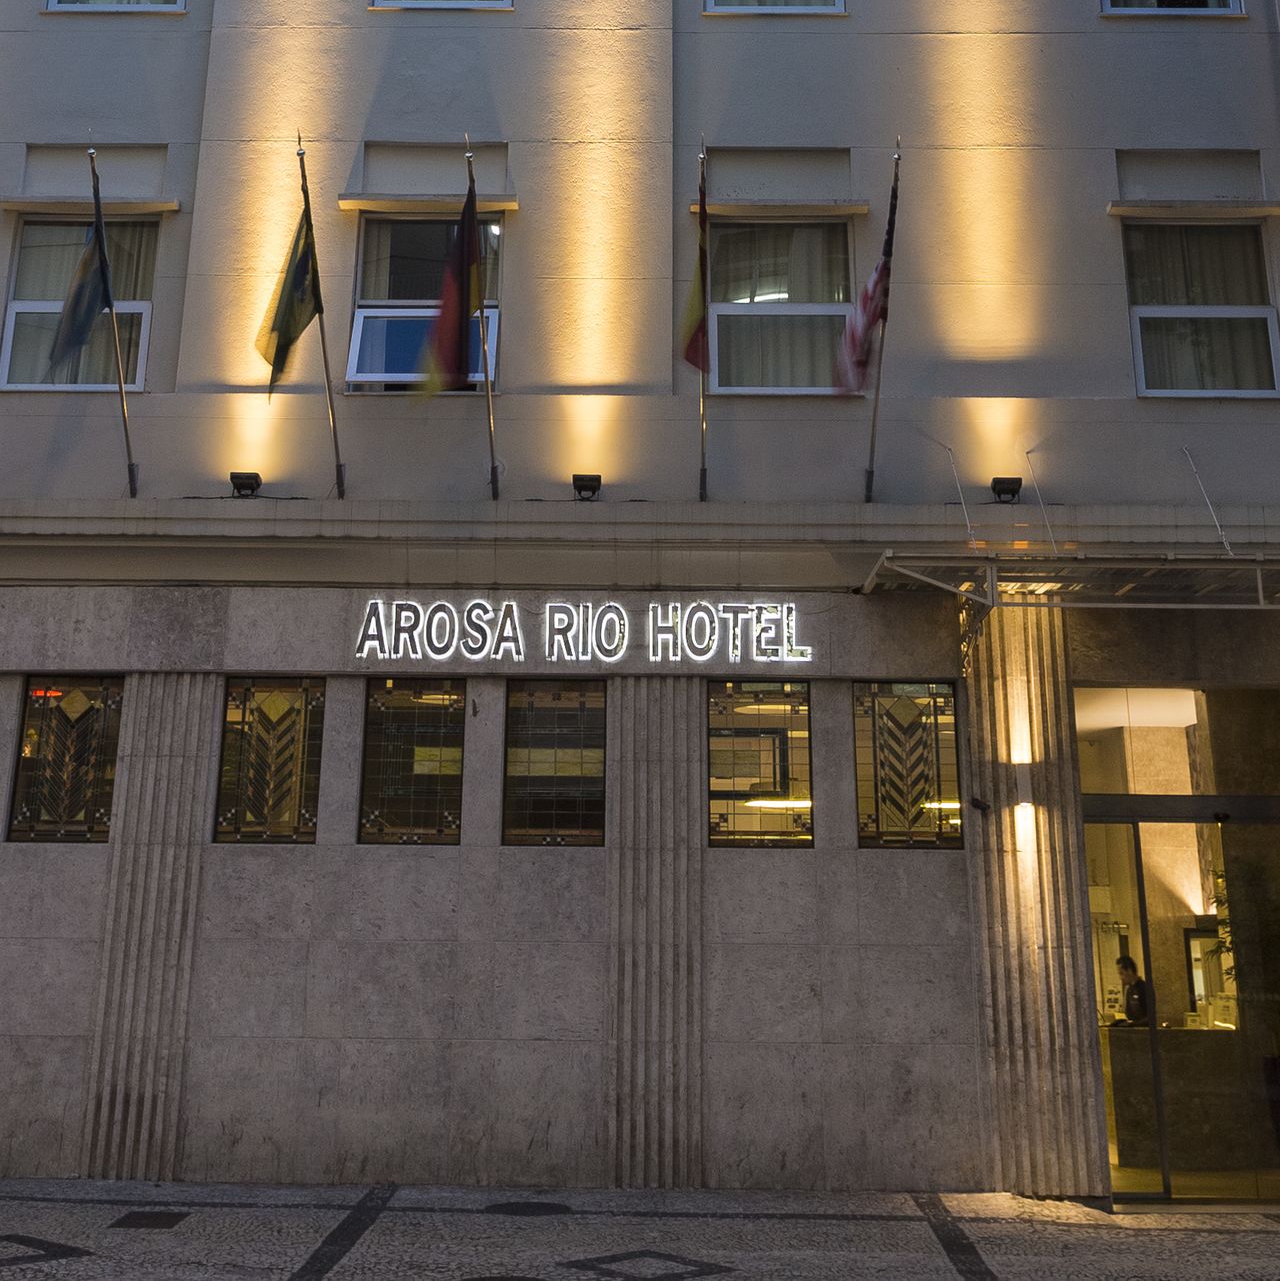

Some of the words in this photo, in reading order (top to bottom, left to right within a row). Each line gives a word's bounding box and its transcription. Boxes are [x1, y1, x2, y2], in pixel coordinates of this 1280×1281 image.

[355, 599, 525, 662] AROSA
[545, 600, 629, 663] RIO
[648, 600, 813, 663] HOTEL
